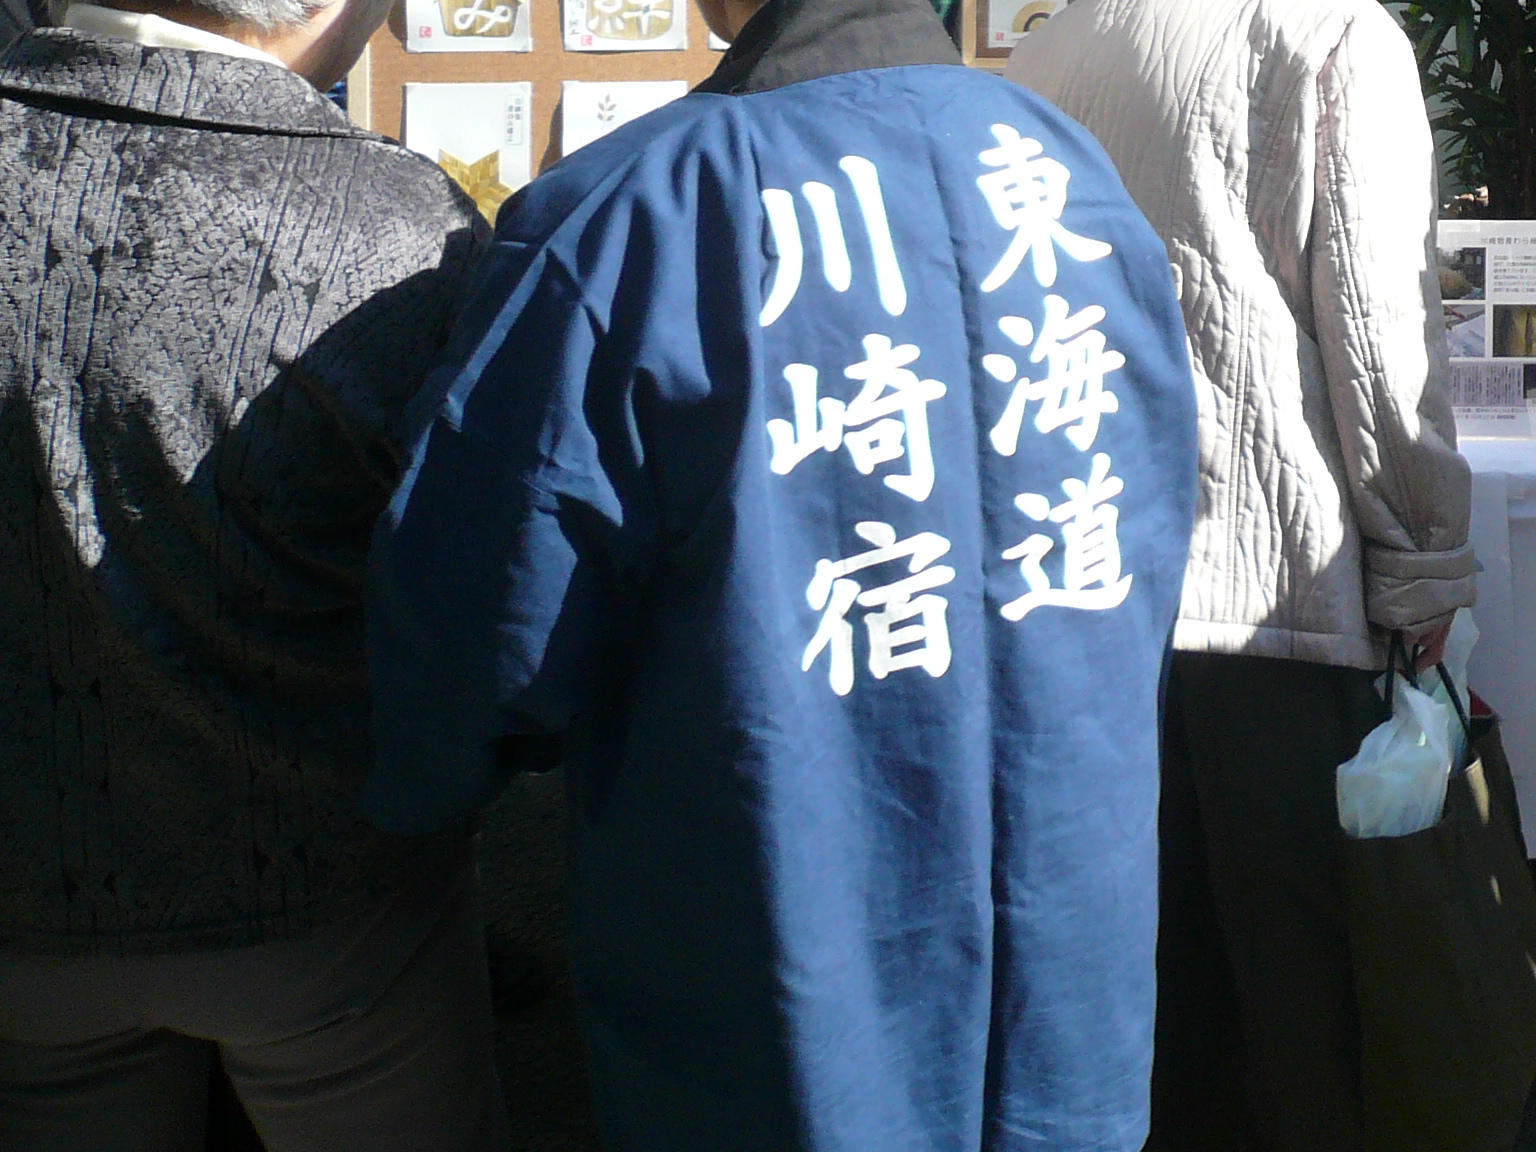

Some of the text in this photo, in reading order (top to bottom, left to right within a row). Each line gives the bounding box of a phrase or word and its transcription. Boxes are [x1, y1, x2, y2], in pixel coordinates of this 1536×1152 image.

[759, 155, 957, 696] 川崎宿
[976, 123, 1134, 622] 東海道
